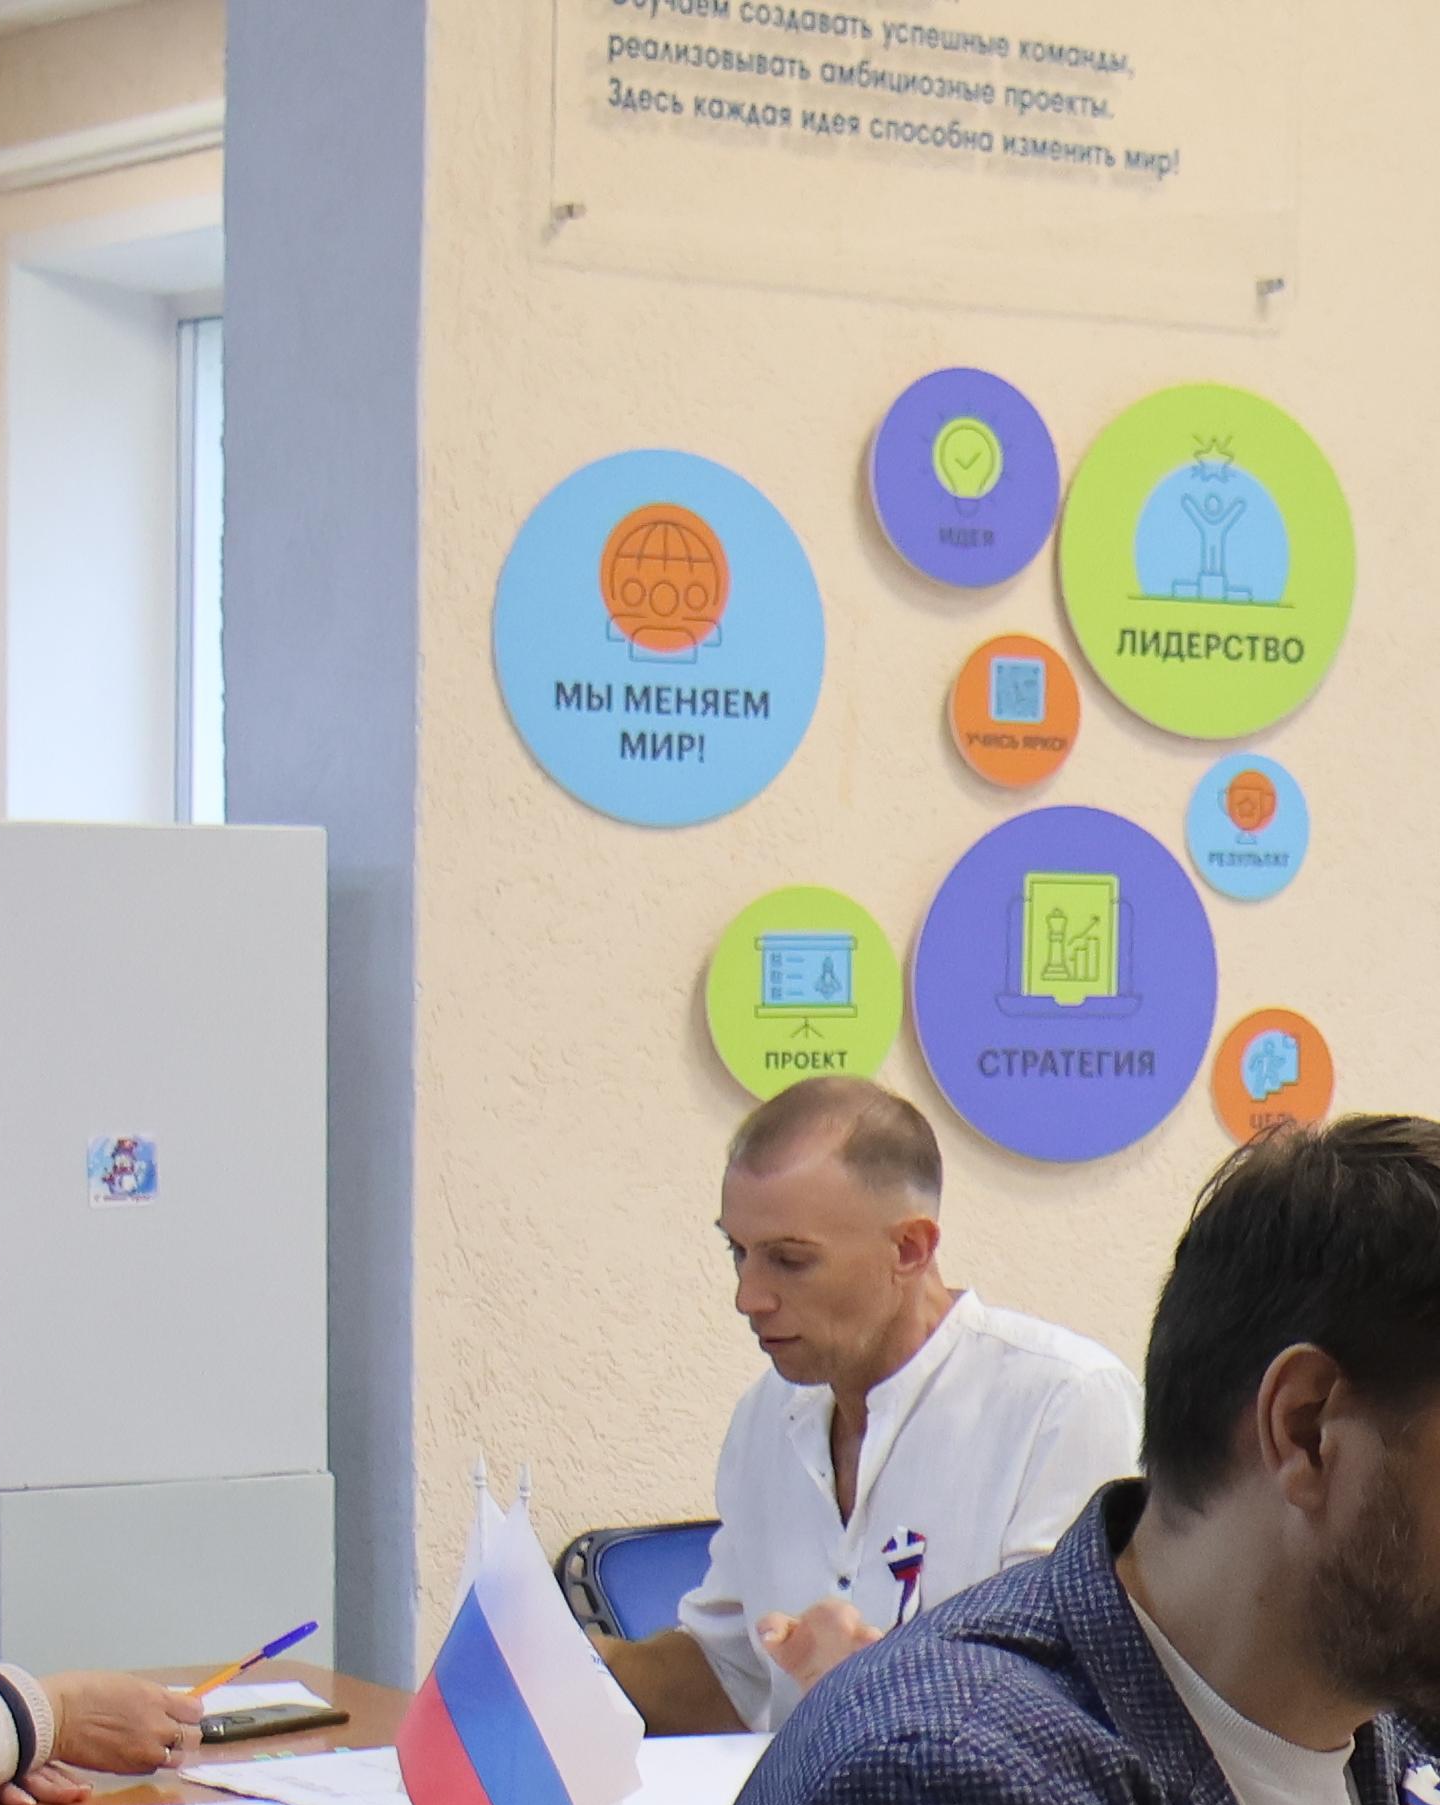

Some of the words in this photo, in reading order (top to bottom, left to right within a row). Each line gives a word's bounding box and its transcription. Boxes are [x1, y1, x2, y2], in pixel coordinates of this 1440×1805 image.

[739, 2, 873, 38] создавать
[882, 20, 1009, 57] успешные
[1019, 38, 1135, 79] команды,
[608, 34, 811, 80] реализовывать
[820, 56, 995, 105] амбициозные
[608, 77, 684, 115] Здесь
[693, 95, 792, 127] каждая
[801, 109, 860, 135] идея
[870, 116, 995, 152] способна
[1002, 133, 1116, 168] изменить
[1124, 148, 1180, 182] мир!
[1116, 627, 1306, 665] ЛИДЕРСТВО
[554, 679, 613, 713] МЫ
[623, 682, 771, 721] МЕНЯЕМ
[619, 730, 706, 764] МИР!
[764, 1050, 849, 1071] ПРОЕКТ
[977, 1047, 1157, 1080] СТРАТЕГИЯ
